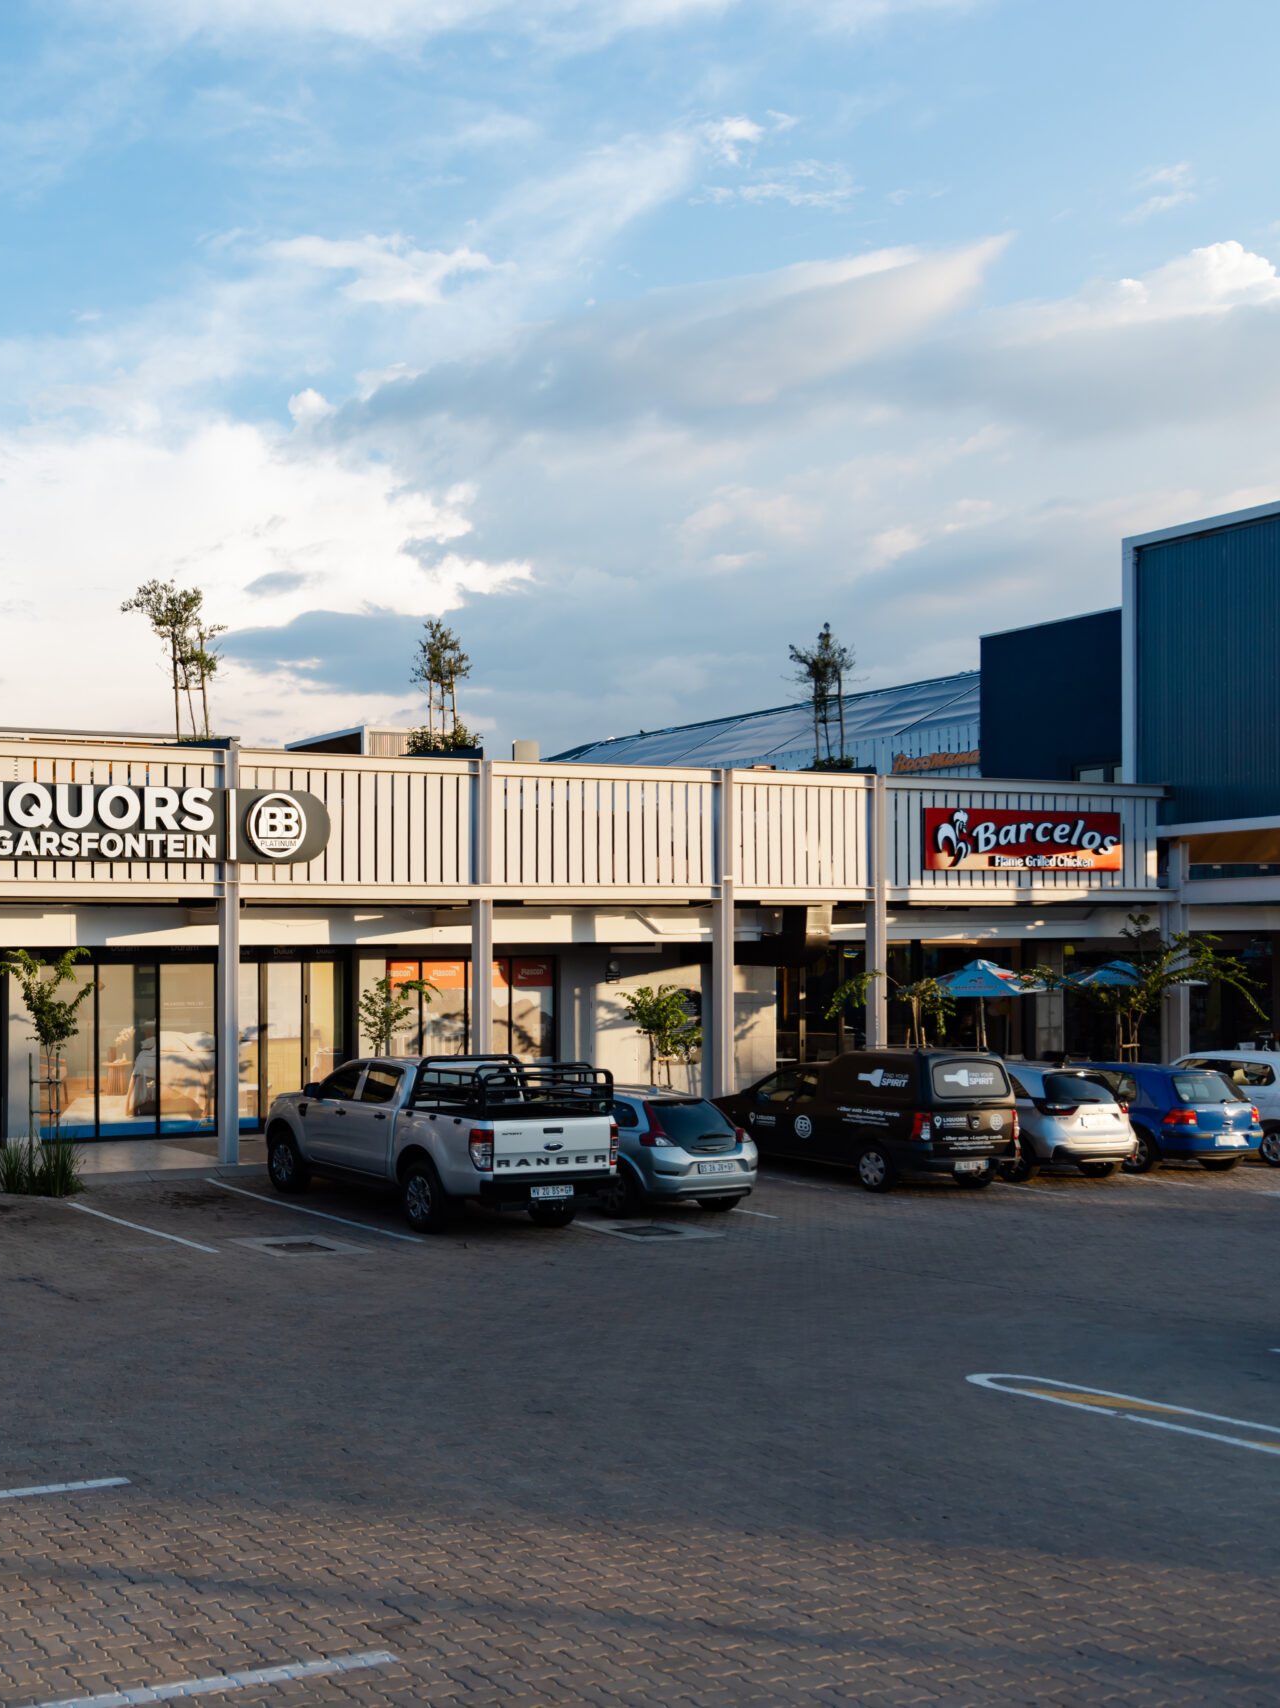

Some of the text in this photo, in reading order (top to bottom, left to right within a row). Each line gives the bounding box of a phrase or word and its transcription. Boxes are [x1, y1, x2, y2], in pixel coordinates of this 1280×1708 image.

[972, 820, 1118, 855] Barcelos
[995, 855, 1094, 867] Flame Grilled Chicken
[881, 1078, 909, 1088] SPIRIT
[969, 1077, 994, 1085] SPIRIT
[497, 1154, 607, 1168] RANGER
